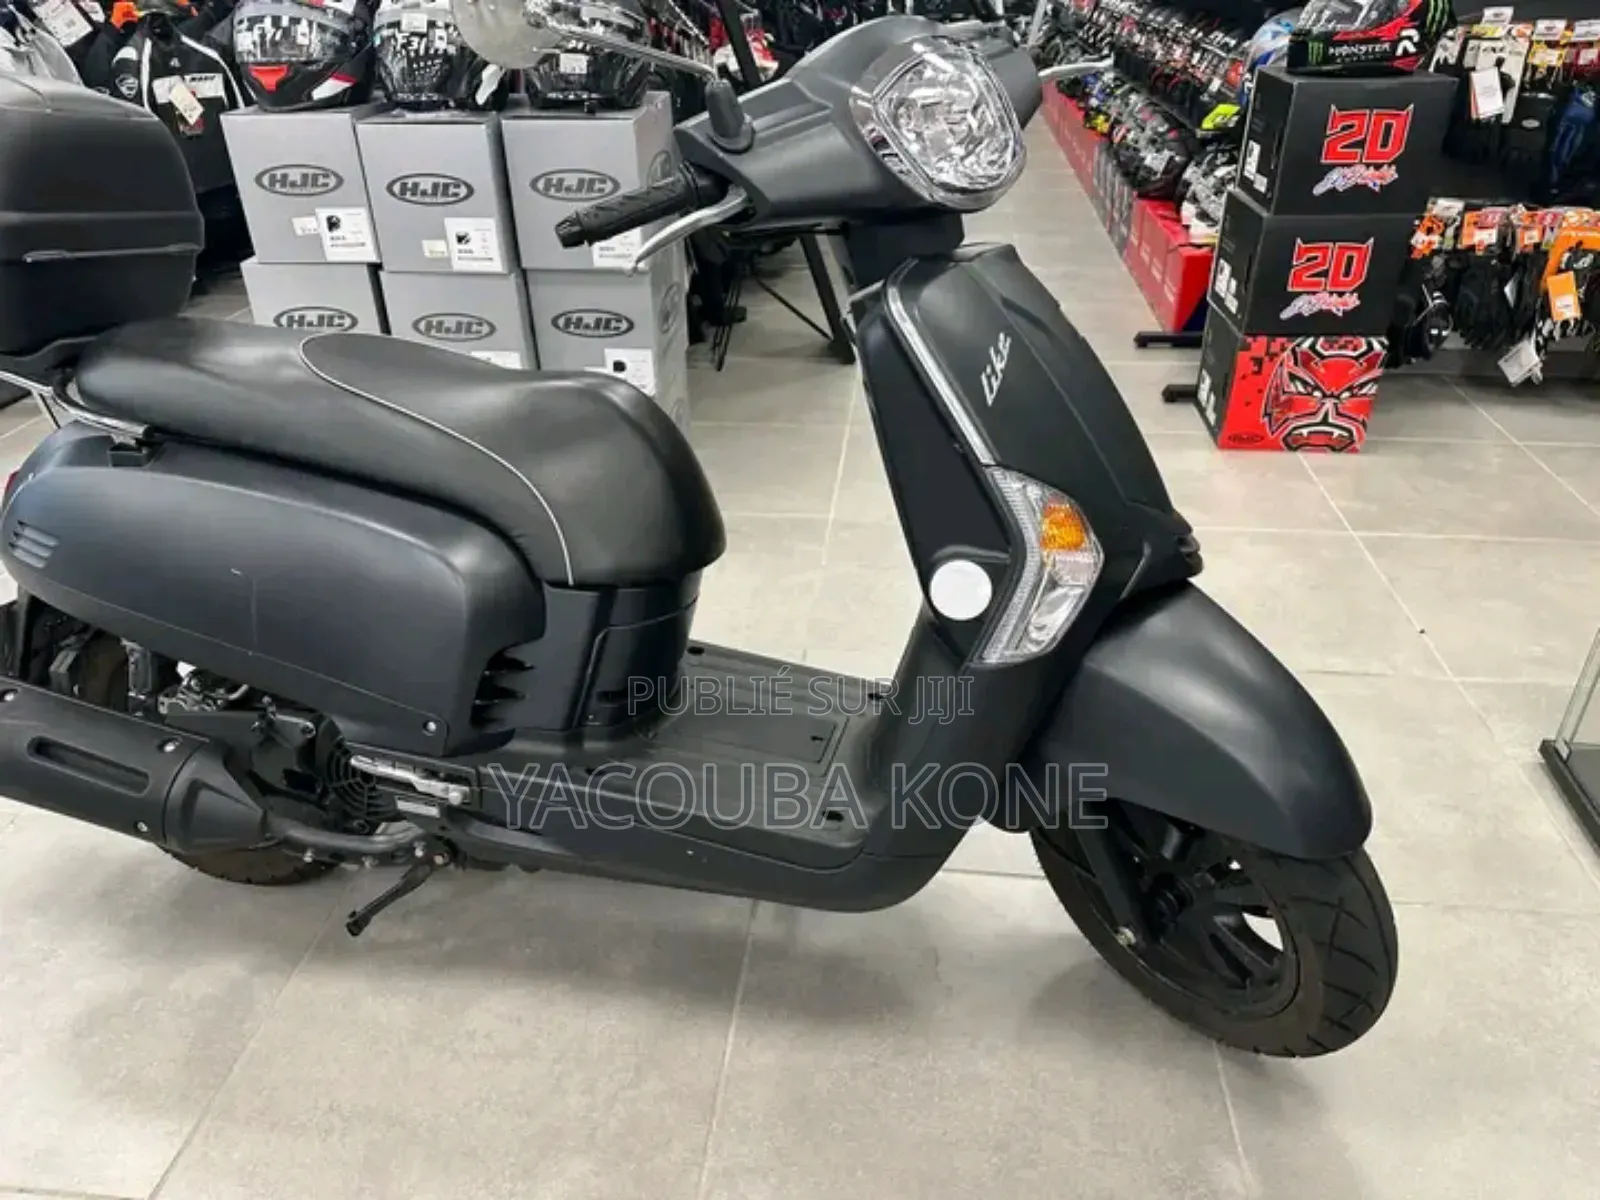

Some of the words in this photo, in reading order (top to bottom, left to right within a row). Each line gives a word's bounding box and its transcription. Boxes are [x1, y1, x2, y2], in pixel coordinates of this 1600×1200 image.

[267, 172, 331, 189] HJC
[542, 177, 608, 194] HJC
[399, 181, 462, 198] HJC
[286, 314, 346, 328] HJC
[423, 319, 484, 335] HJC
[562, 315, 624, 331] HJC
